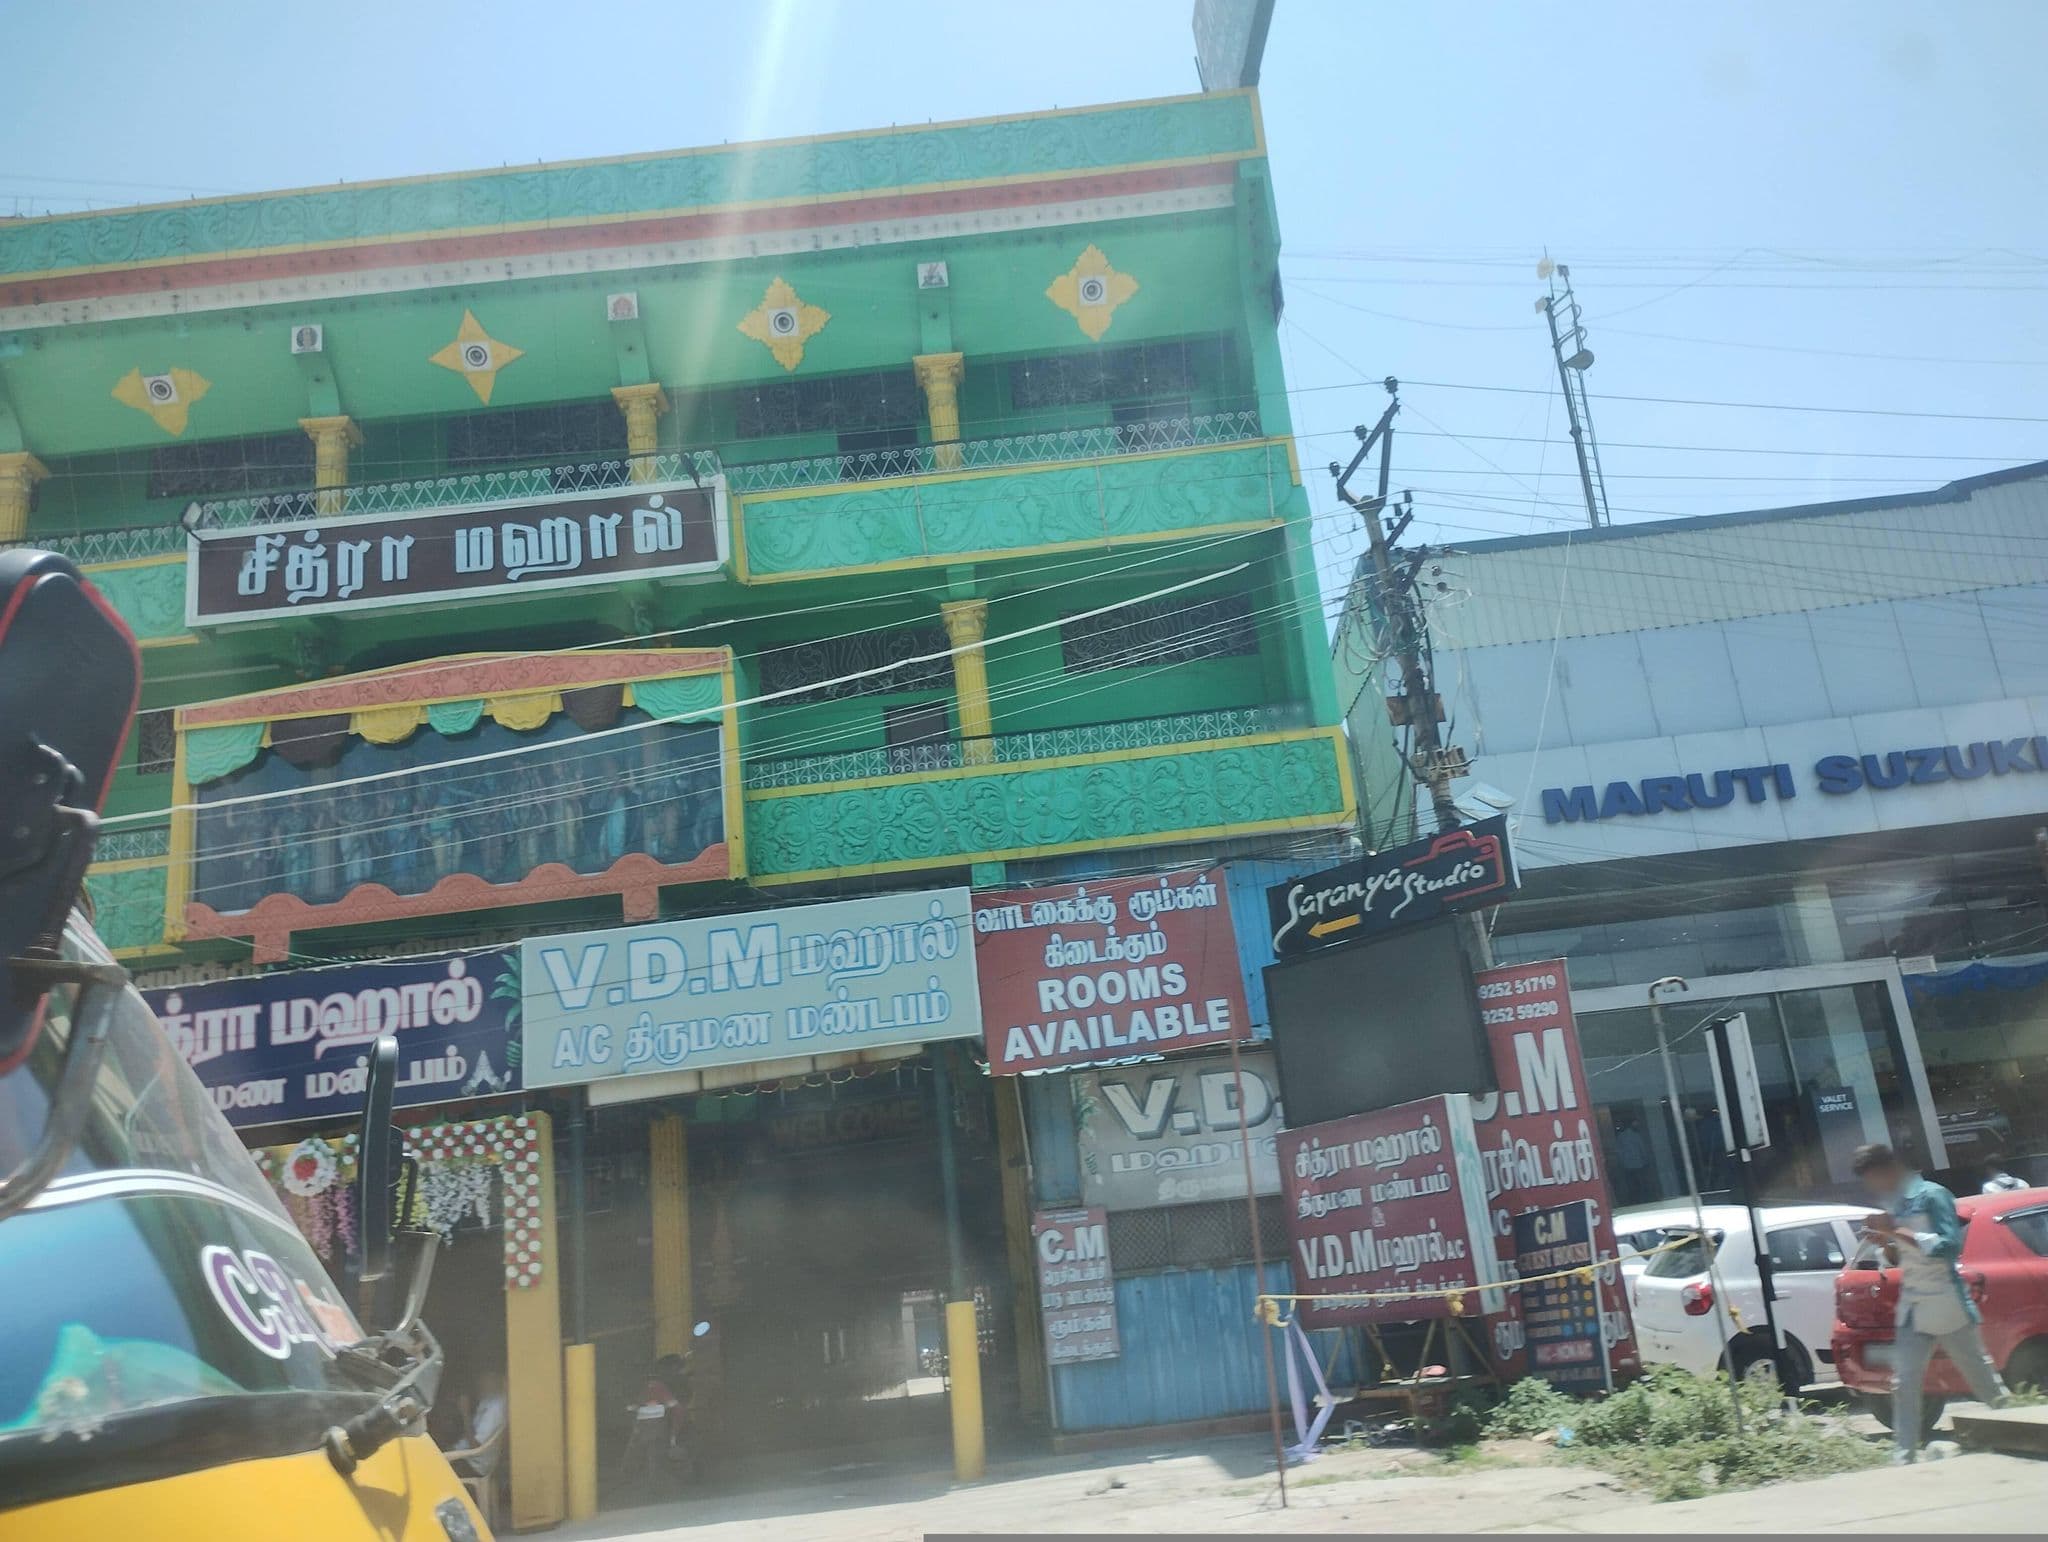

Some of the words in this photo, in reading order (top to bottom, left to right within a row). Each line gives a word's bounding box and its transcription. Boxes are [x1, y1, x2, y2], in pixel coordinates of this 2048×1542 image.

[455, 495, 683, 581] மஹால்
[1541, 763, 1796, 824] MARUTI
[1815, 736, 2048, 795] SUZUKI
[975, 886, 1117, 932] வாடகைக்கு
[1129, 874, 1217, 921] ரூம்கள்
[1273, 868, 1401, 953] Saranya
[1390, 861, 1485, 919] Studio
[540, 923, 783, 1011] V.D.M
[790, 900, 958, 992] மஹால்
[1044, 920, 1168, 968] கிடைக்கும்
[270, 959, 483, 1061] மஹால்
[1038, 963, 1187, 1013] ROOMS
[553, 1024, 613, 1068] A/C
[623, 1012, 773, 1072] திருமண
[786, 976, 951, 1040] மண்டபம்
[1004, 998, 1231, 1062] AVAILABLE
[1819, 1102, 1854, 1113] SERVICE
[1820, 1094, 1847, 1104] VALET
[1354, 1114, 1441, 1171] மஹால்
[1371, 1164, 1451, 1203] மண்டபம்
[1039, 1225, 1105, 1263] C.M
[1298, 1229, 1379, 1279] V.D.M
[1377, 1217, 1446, 1277] மஹால்
[1534, 1210, 1568, 1245] C.M
